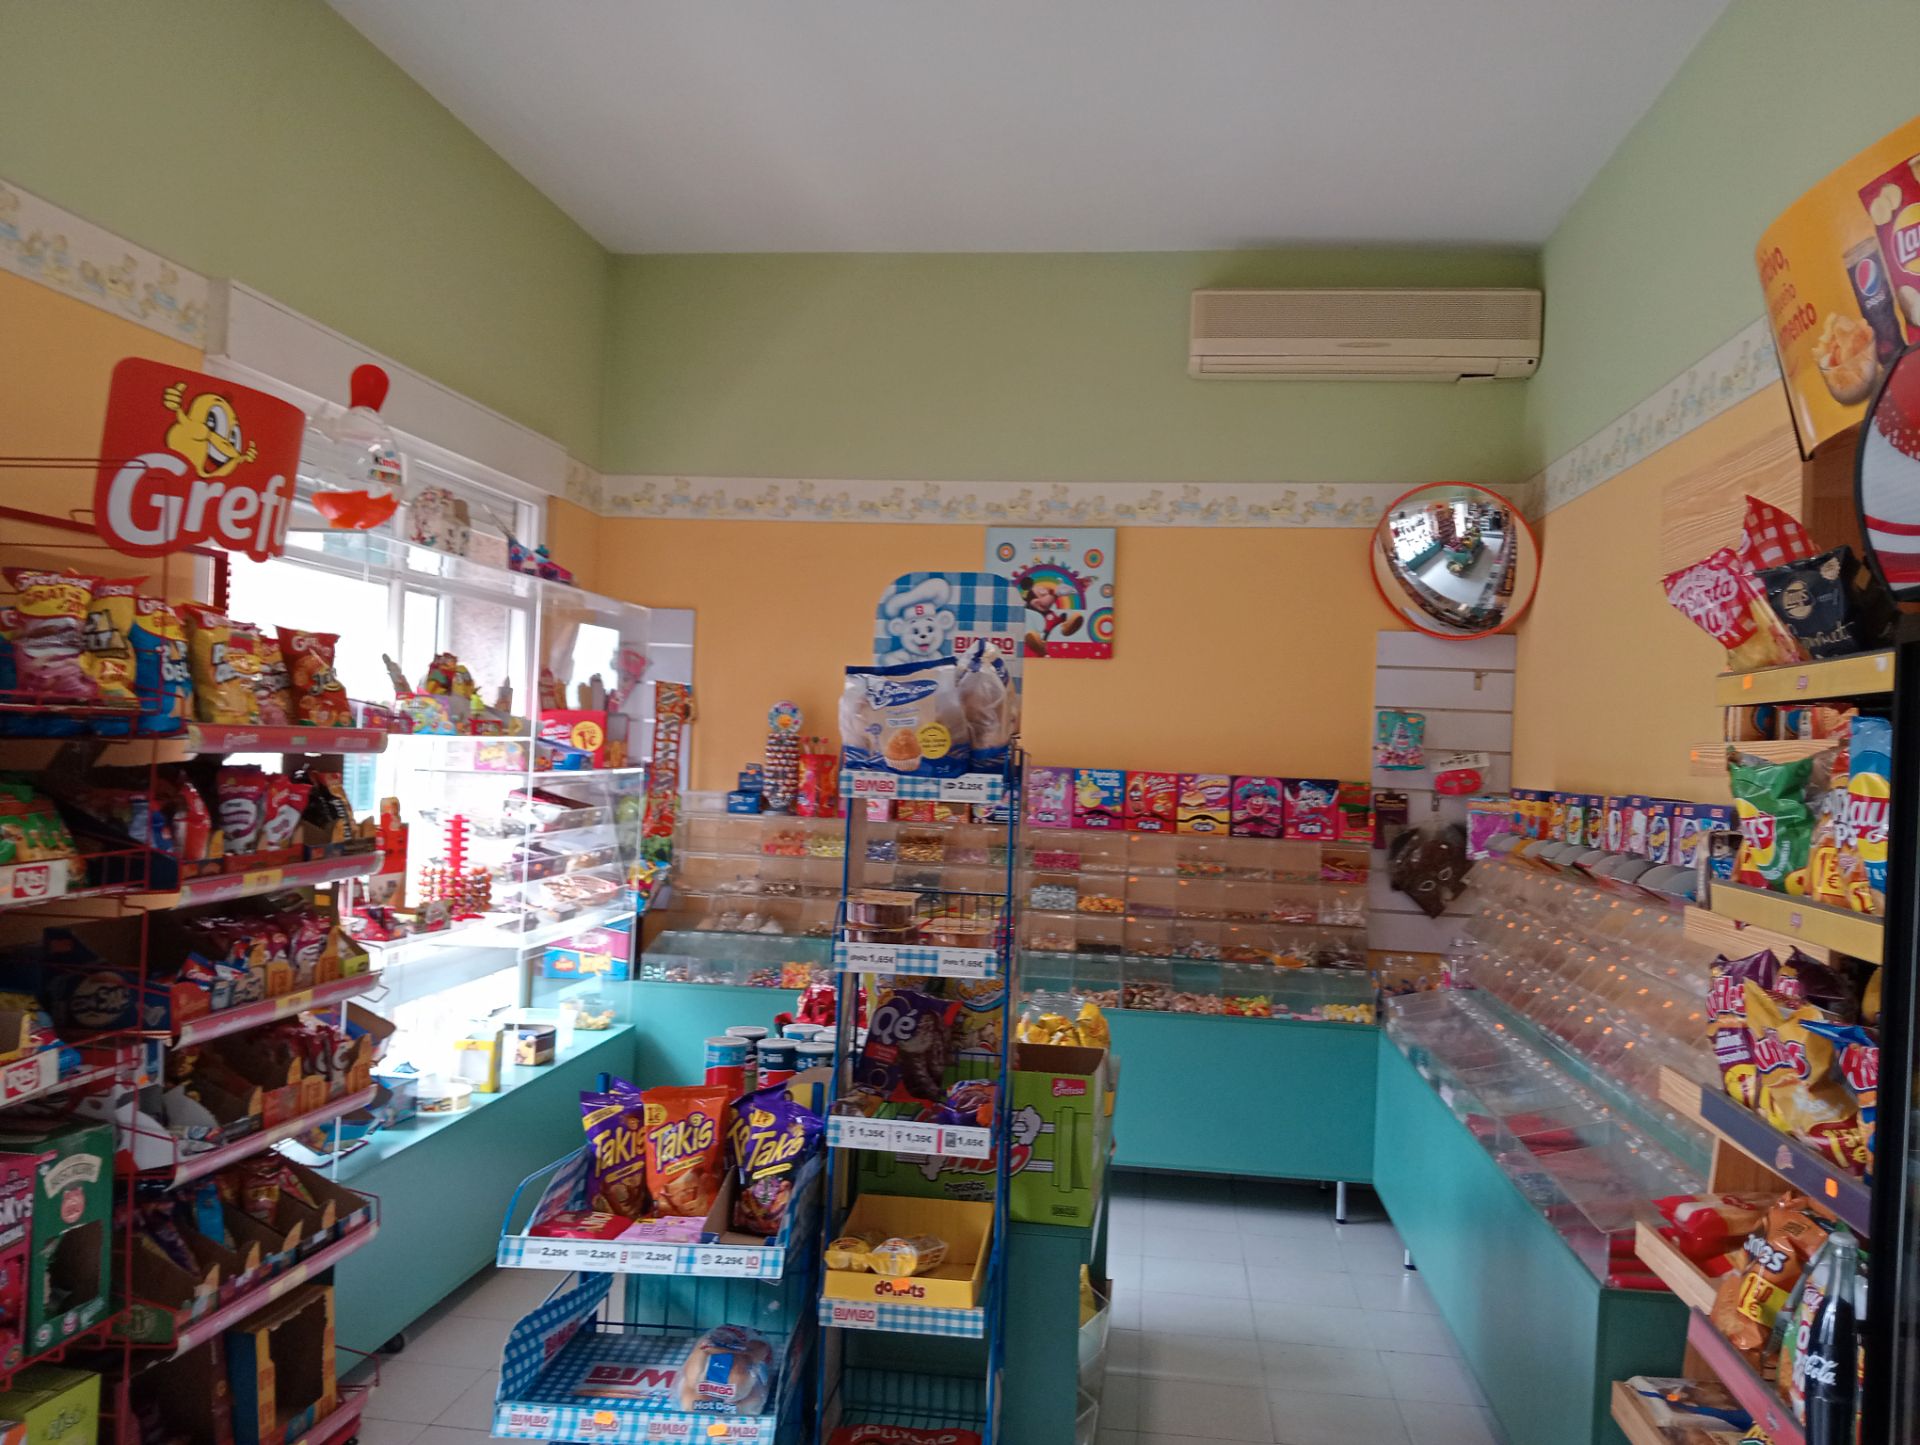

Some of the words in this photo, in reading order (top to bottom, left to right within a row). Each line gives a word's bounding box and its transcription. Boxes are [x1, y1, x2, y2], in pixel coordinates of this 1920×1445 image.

[854, 779, 896, 792] BIMBO
[649, 1113, 714, 1171] Takis
[834, 1307, 876, 1322] BIMBO
[585, 1366, 677, 1388] BIM
[698, 1384, 734, 1396] BIMBO
[694, 1401, 715, 1410] Hot
[716, 1402, 737, 1414] Dog
[511, 1413, 549, 1427] BIMBO
[649, 1422, 688, 1435] BIMBO
